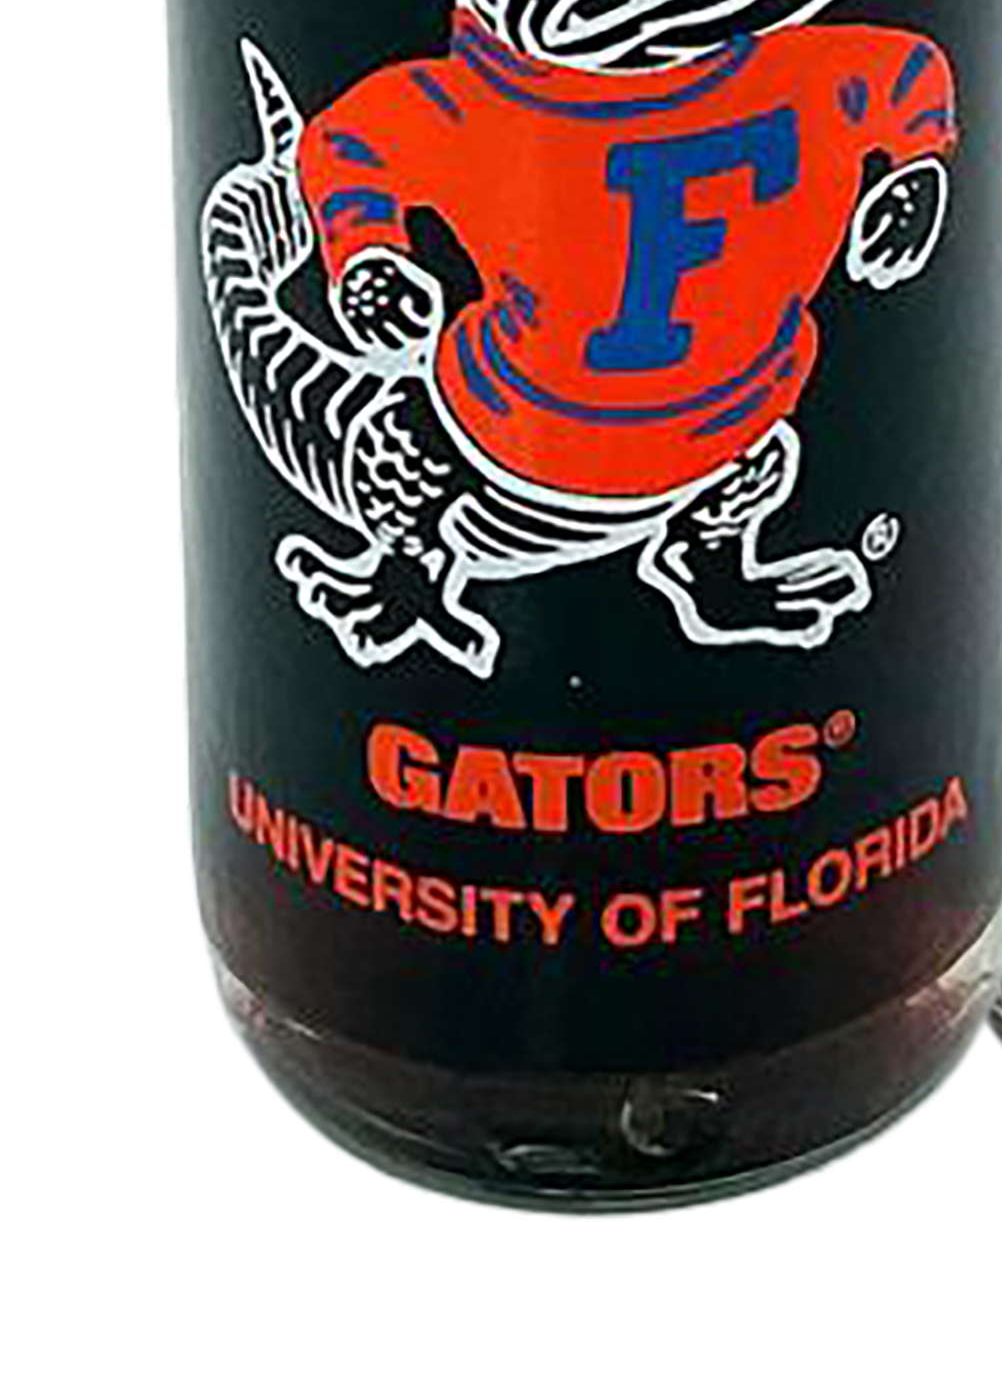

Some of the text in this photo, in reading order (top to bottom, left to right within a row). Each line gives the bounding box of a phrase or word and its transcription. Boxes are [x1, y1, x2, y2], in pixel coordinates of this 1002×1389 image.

[584, 107, 799, 373] F
[228, 768, 969, 948] UNIVERSITY OF FLORIDA
